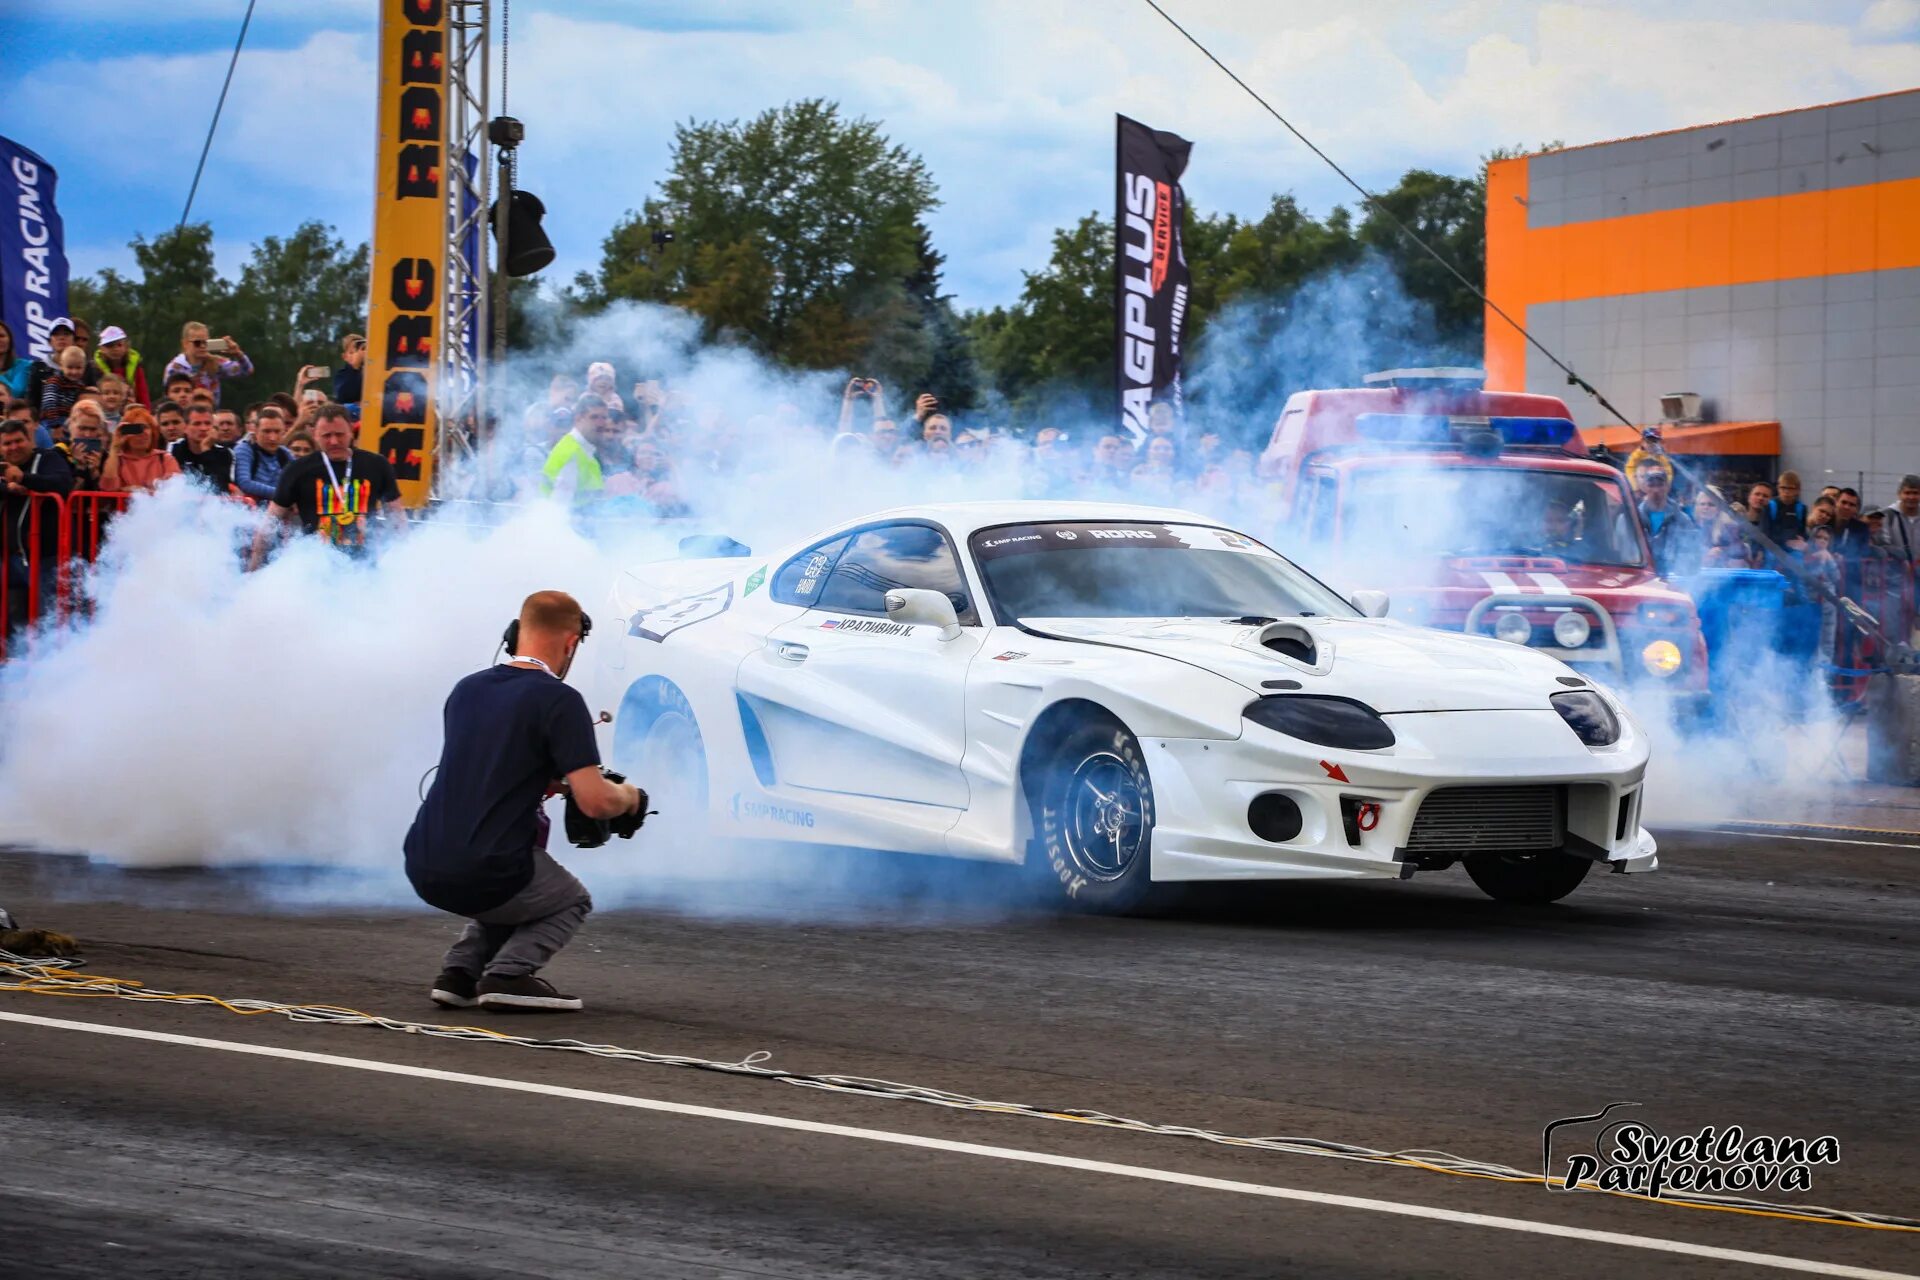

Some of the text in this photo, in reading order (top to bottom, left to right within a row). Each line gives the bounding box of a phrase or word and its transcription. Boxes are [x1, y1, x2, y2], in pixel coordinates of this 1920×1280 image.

[12, 157, 50, 299] RACING
[1156, 191, 1168, 261] SERVICE
[1122, 172, 1155, 450] VAGPLUS
[378, 257, 435, 480] RDRC
[1012, 533, 1042, 544] RACING
[1089, 529, 1156, 539] RDRC
[838, 619, 915, 637] КРАПИВИН К.
[770, 806, 815, 828] RACING
